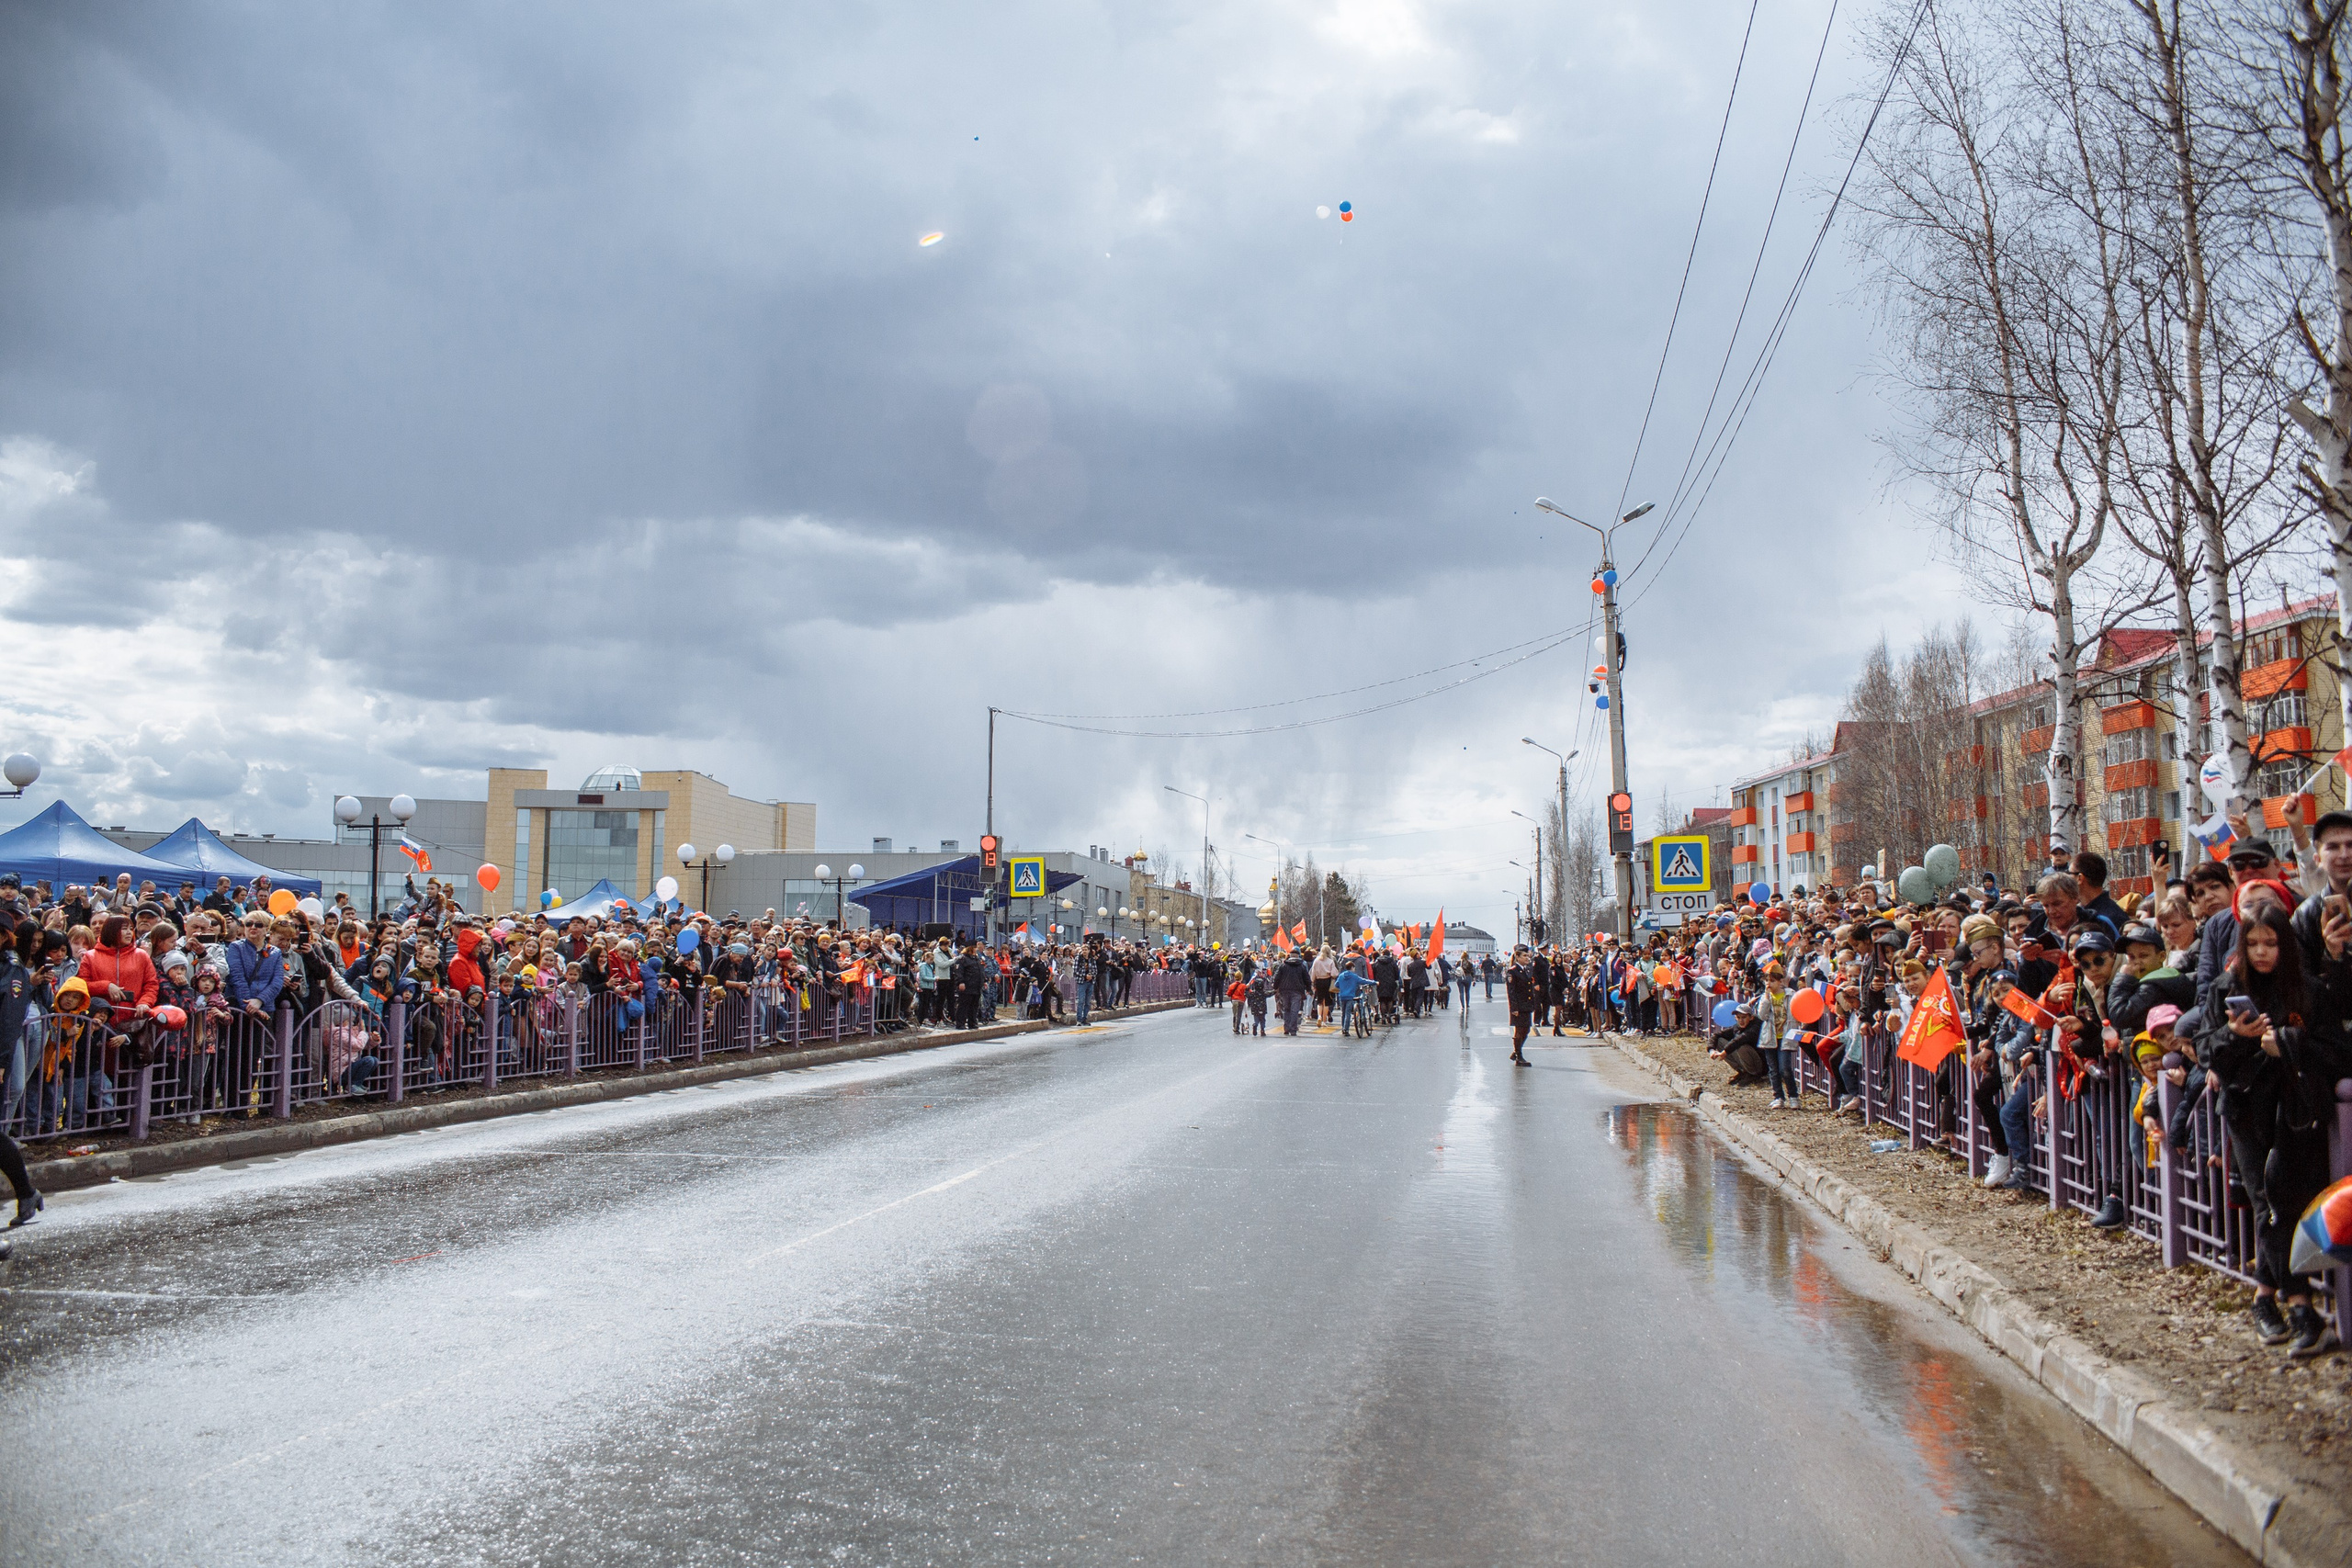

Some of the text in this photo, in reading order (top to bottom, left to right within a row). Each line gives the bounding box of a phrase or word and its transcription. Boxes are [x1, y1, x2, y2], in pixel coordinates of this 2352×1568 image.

[1619, 813, 1633, 830] 13
[985, 852, 996, 867] 13
[1660, 895, 1708, 910] СТОП
